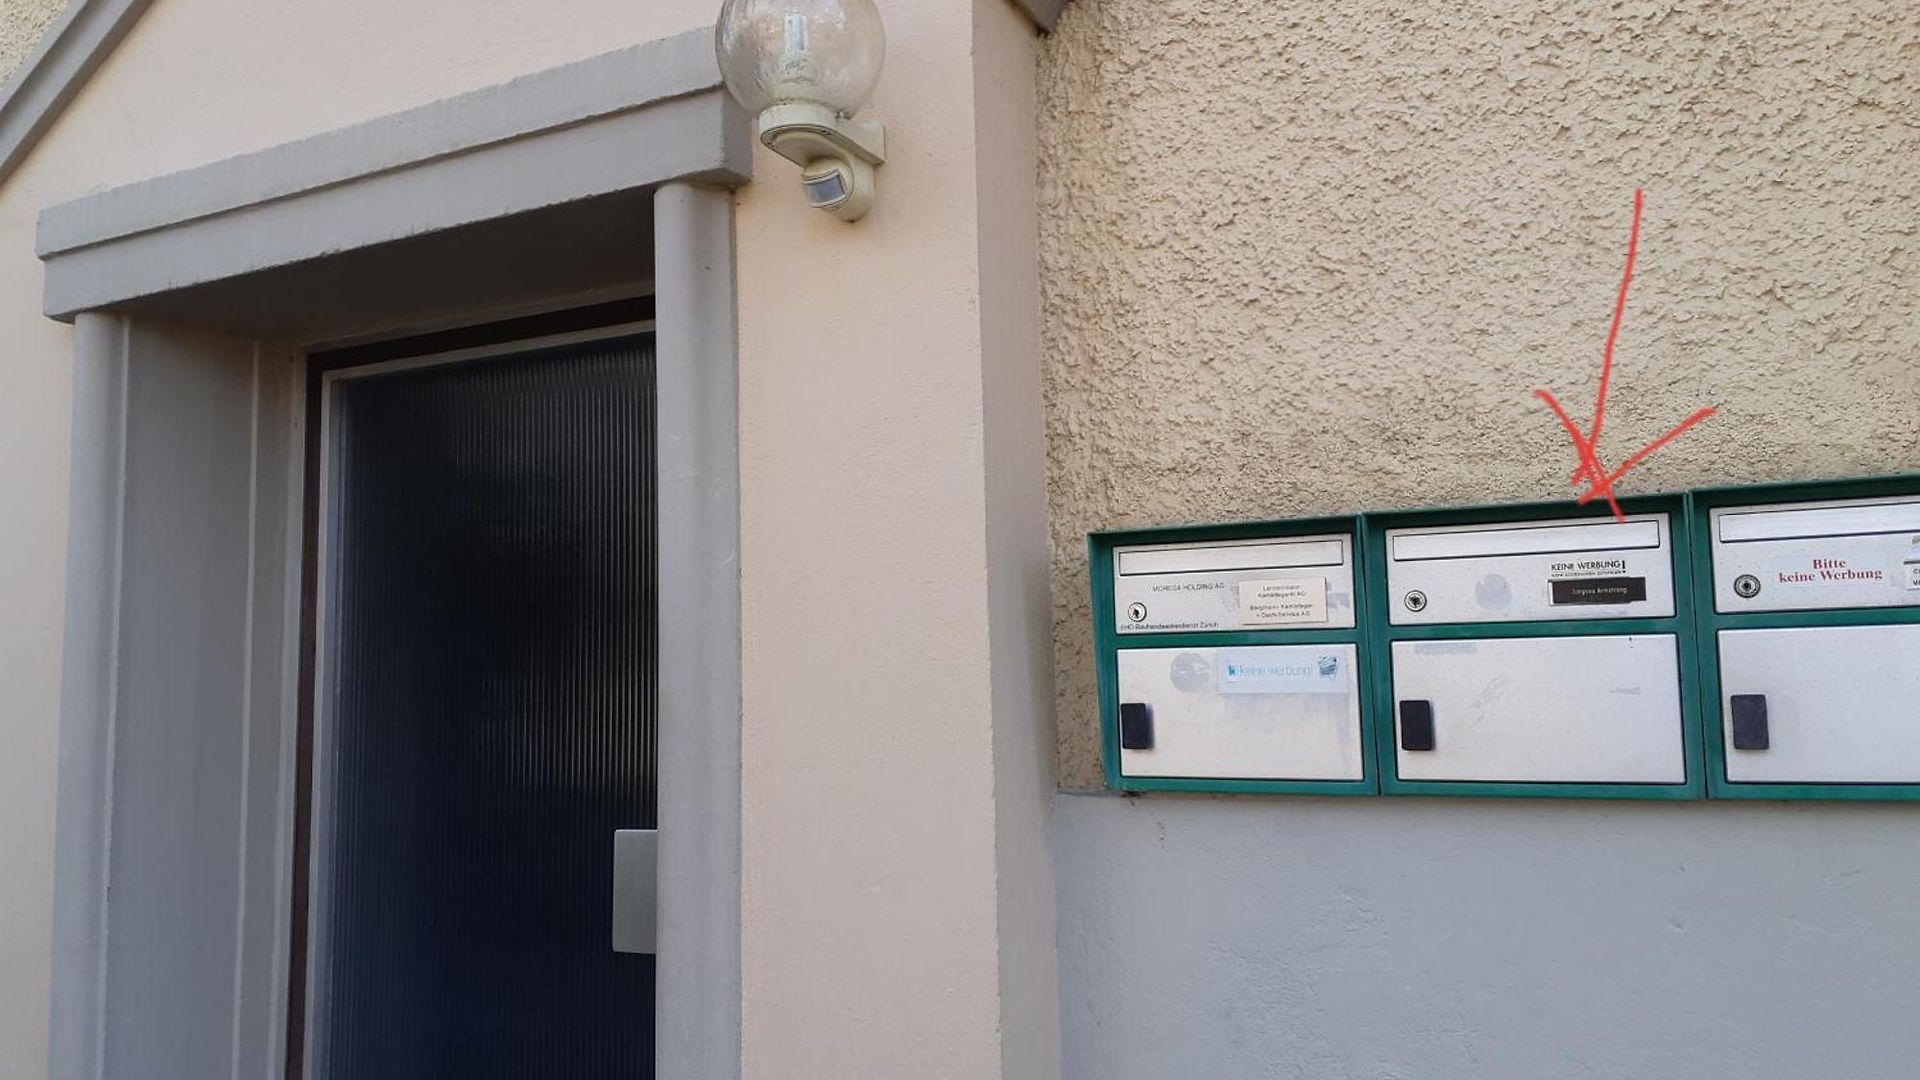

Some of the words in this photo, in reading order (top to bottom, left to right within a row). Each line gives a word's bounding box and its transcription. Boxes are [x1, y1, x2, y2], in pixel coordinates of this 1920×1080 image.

[1551, 562, 1574, 571] KEINE
[1813, 558, 1846, 570] Bitte
[1779, 572, 1816, 583] keine
[1820, 569, 1883, 580] Werbung
